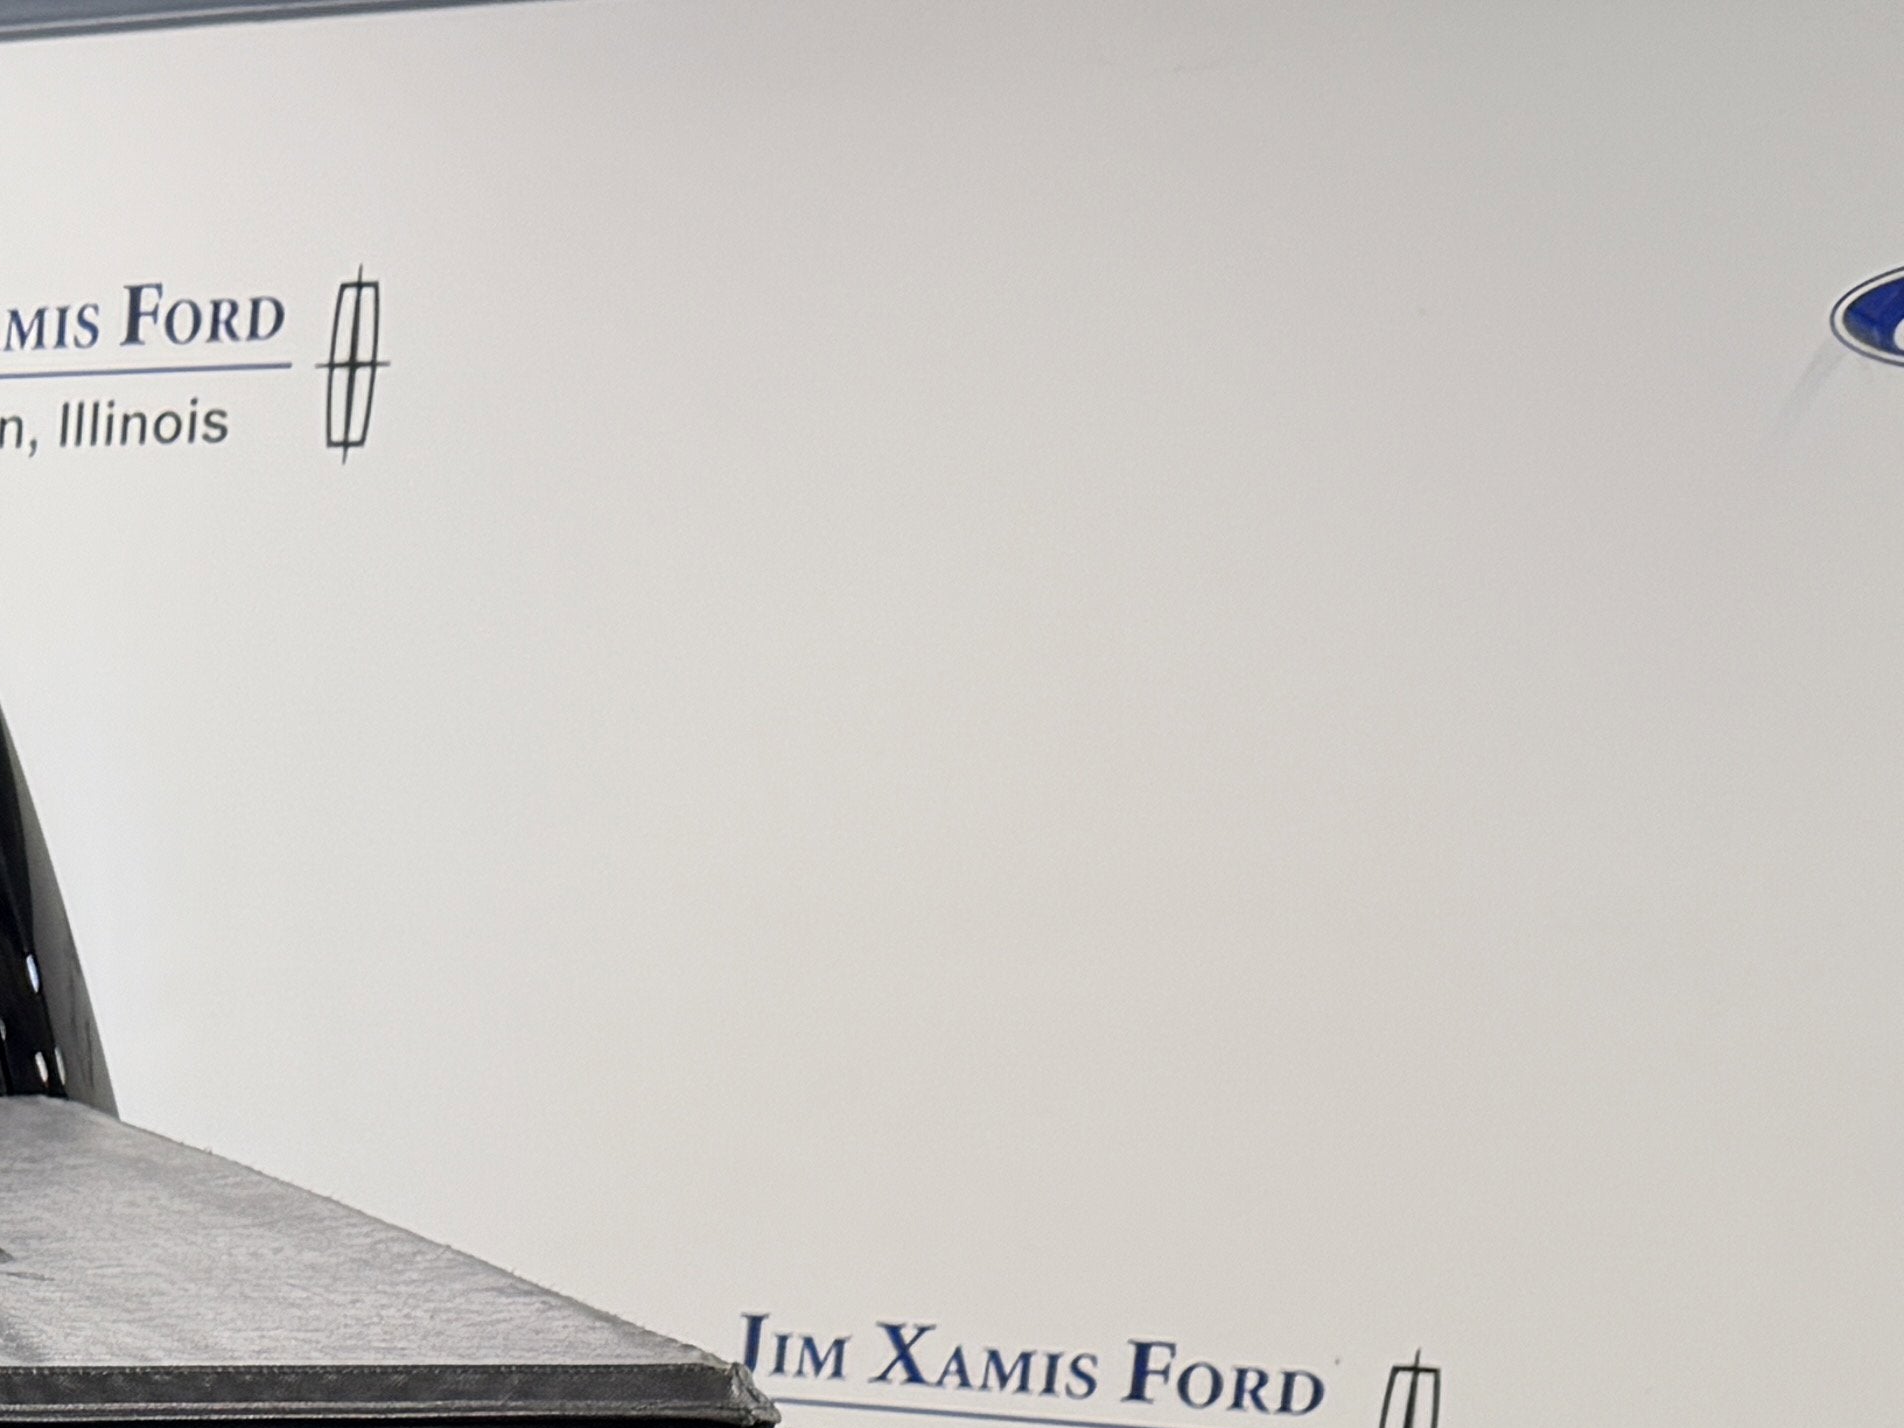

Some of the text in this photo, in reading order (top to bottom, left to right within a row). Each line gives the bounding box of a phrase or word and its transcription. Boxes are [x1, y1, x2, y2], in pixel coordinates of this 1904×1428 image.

[121, 282, 287, 347] FORD
[58, 398, 229, 447] Illinois
[739, 1313, 1326, 1416] JIM XAMIS FORD
